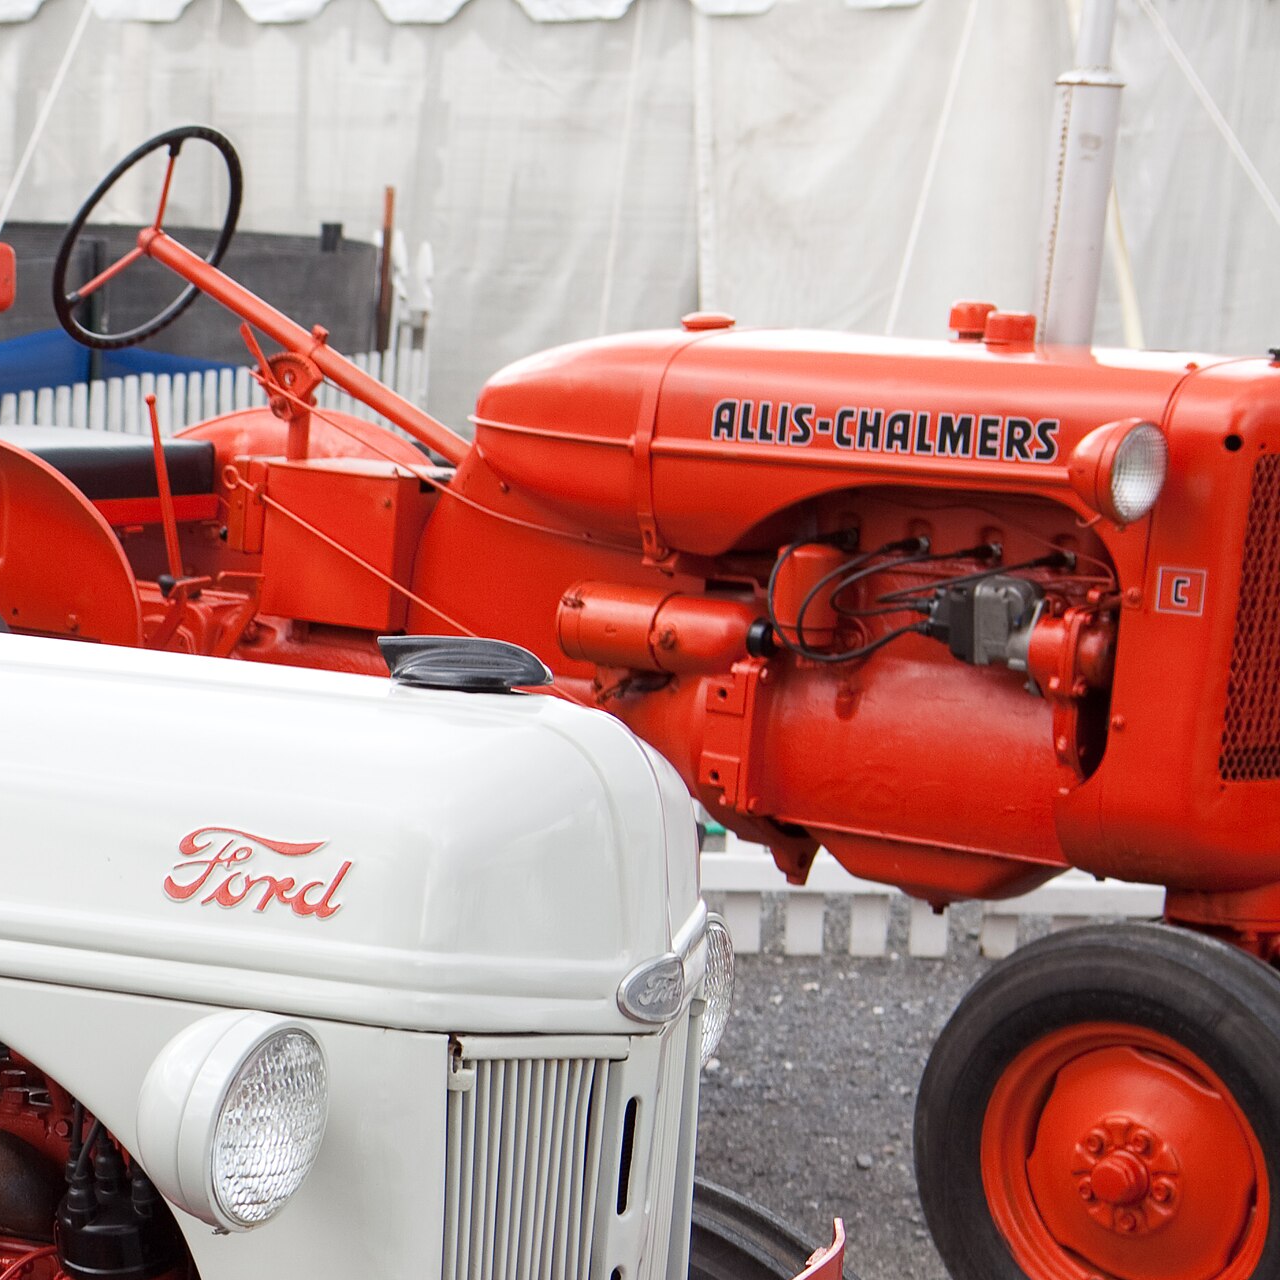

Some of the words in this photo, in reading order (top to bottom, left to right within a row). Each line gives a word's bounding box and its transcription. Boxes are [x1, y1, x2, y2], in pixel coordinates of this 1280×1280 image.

[712, 399, 1060, 463] ALLIS-CHALMERS
[1172, 576, 1190, 606] C
[162, 826, 353, 919] Ford
